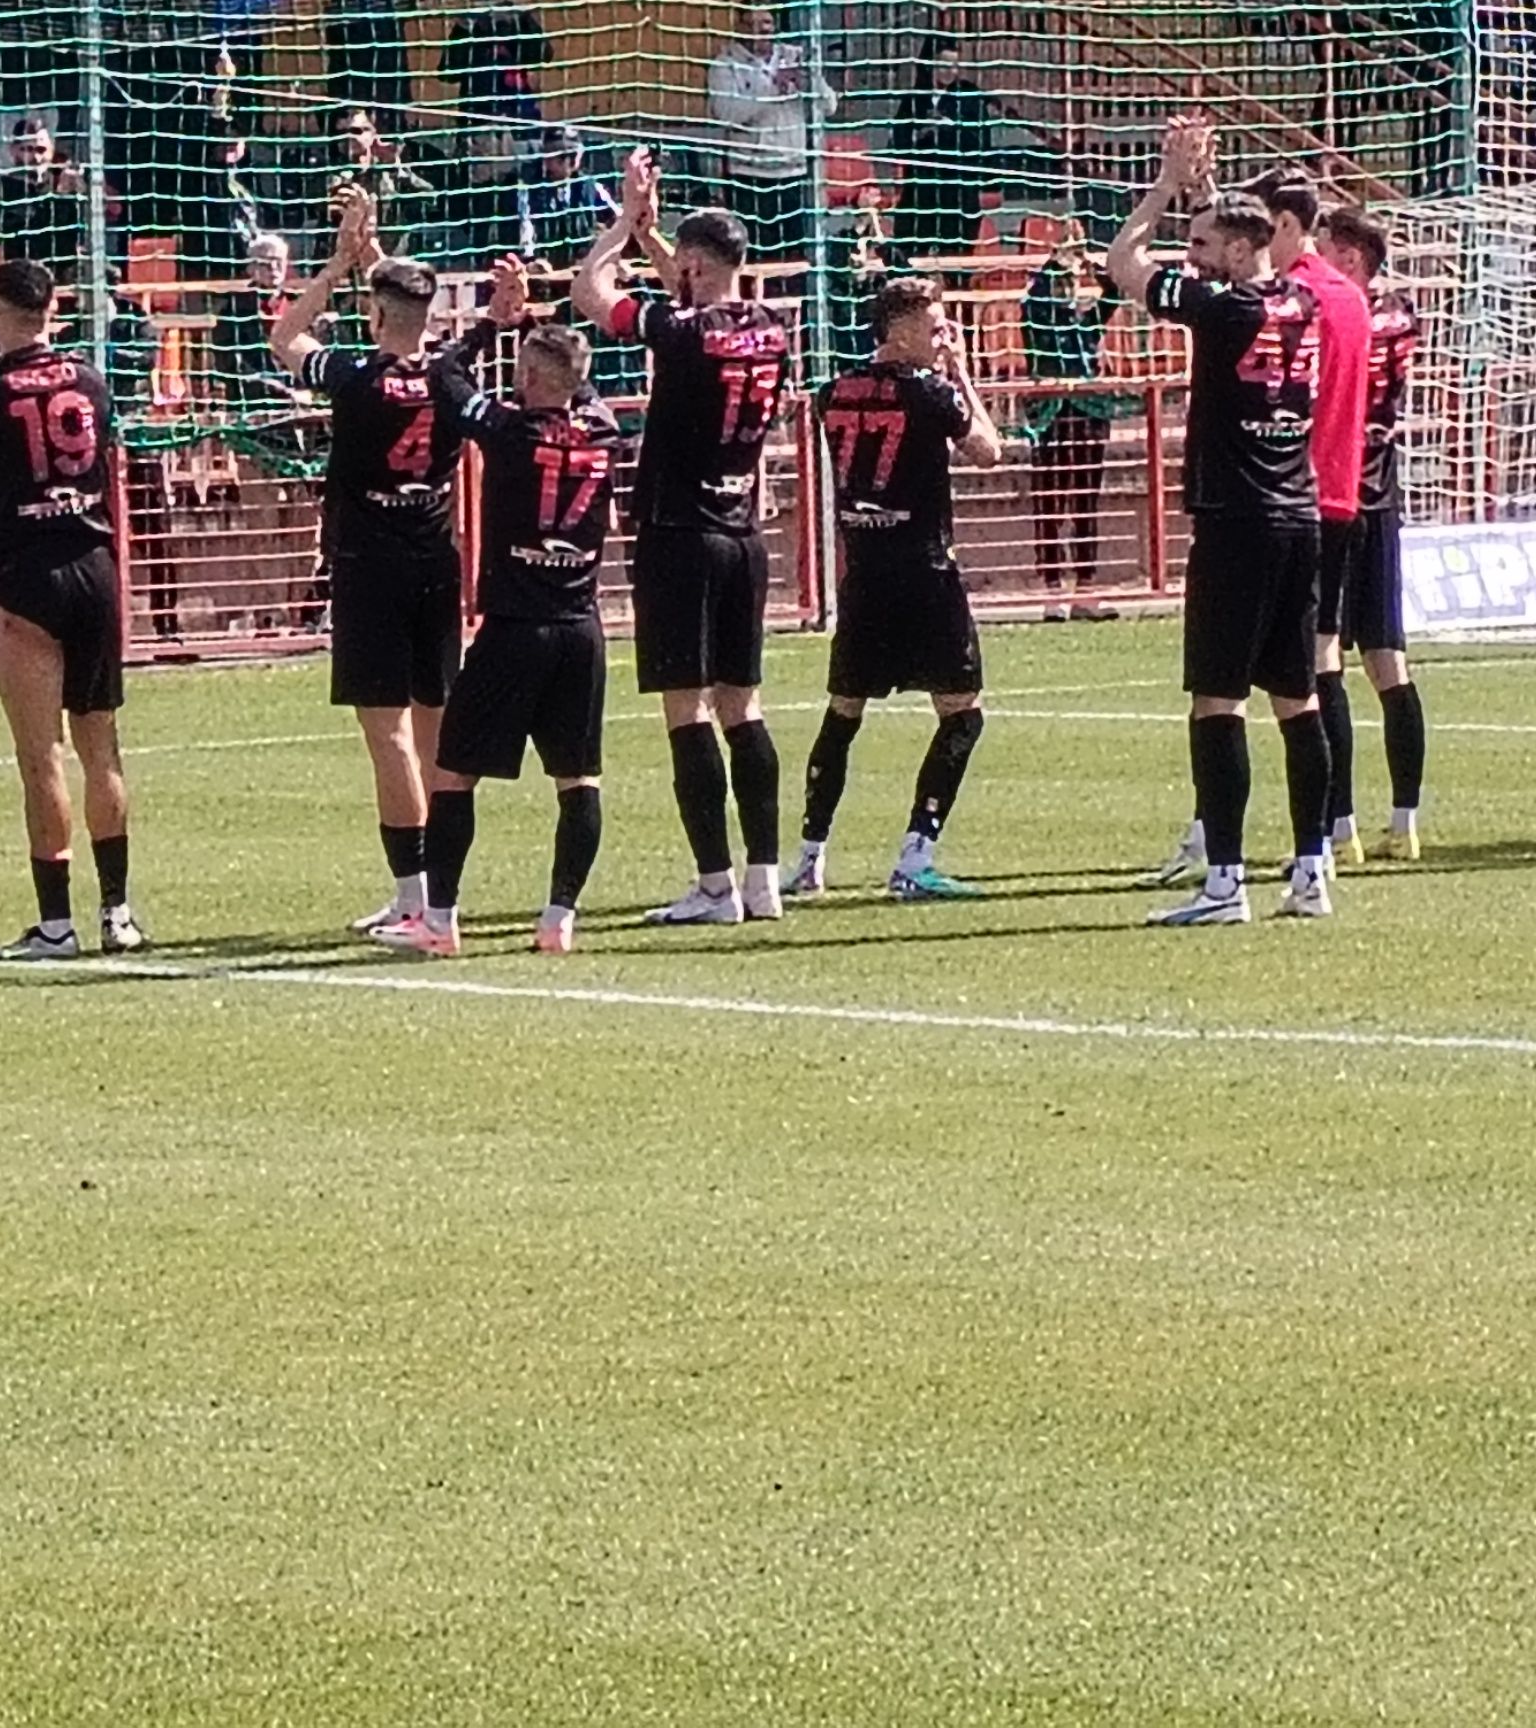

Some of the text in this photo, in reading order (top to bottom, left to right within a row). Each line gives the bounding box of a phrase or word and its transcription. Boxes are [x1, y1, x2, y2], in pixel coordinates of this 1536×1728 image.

[10, 390, 97, 483] 19
[386, 408, 435, 480] 4
[824, 409, 906, 491] 77
[533, 445, 609, 531] 17
